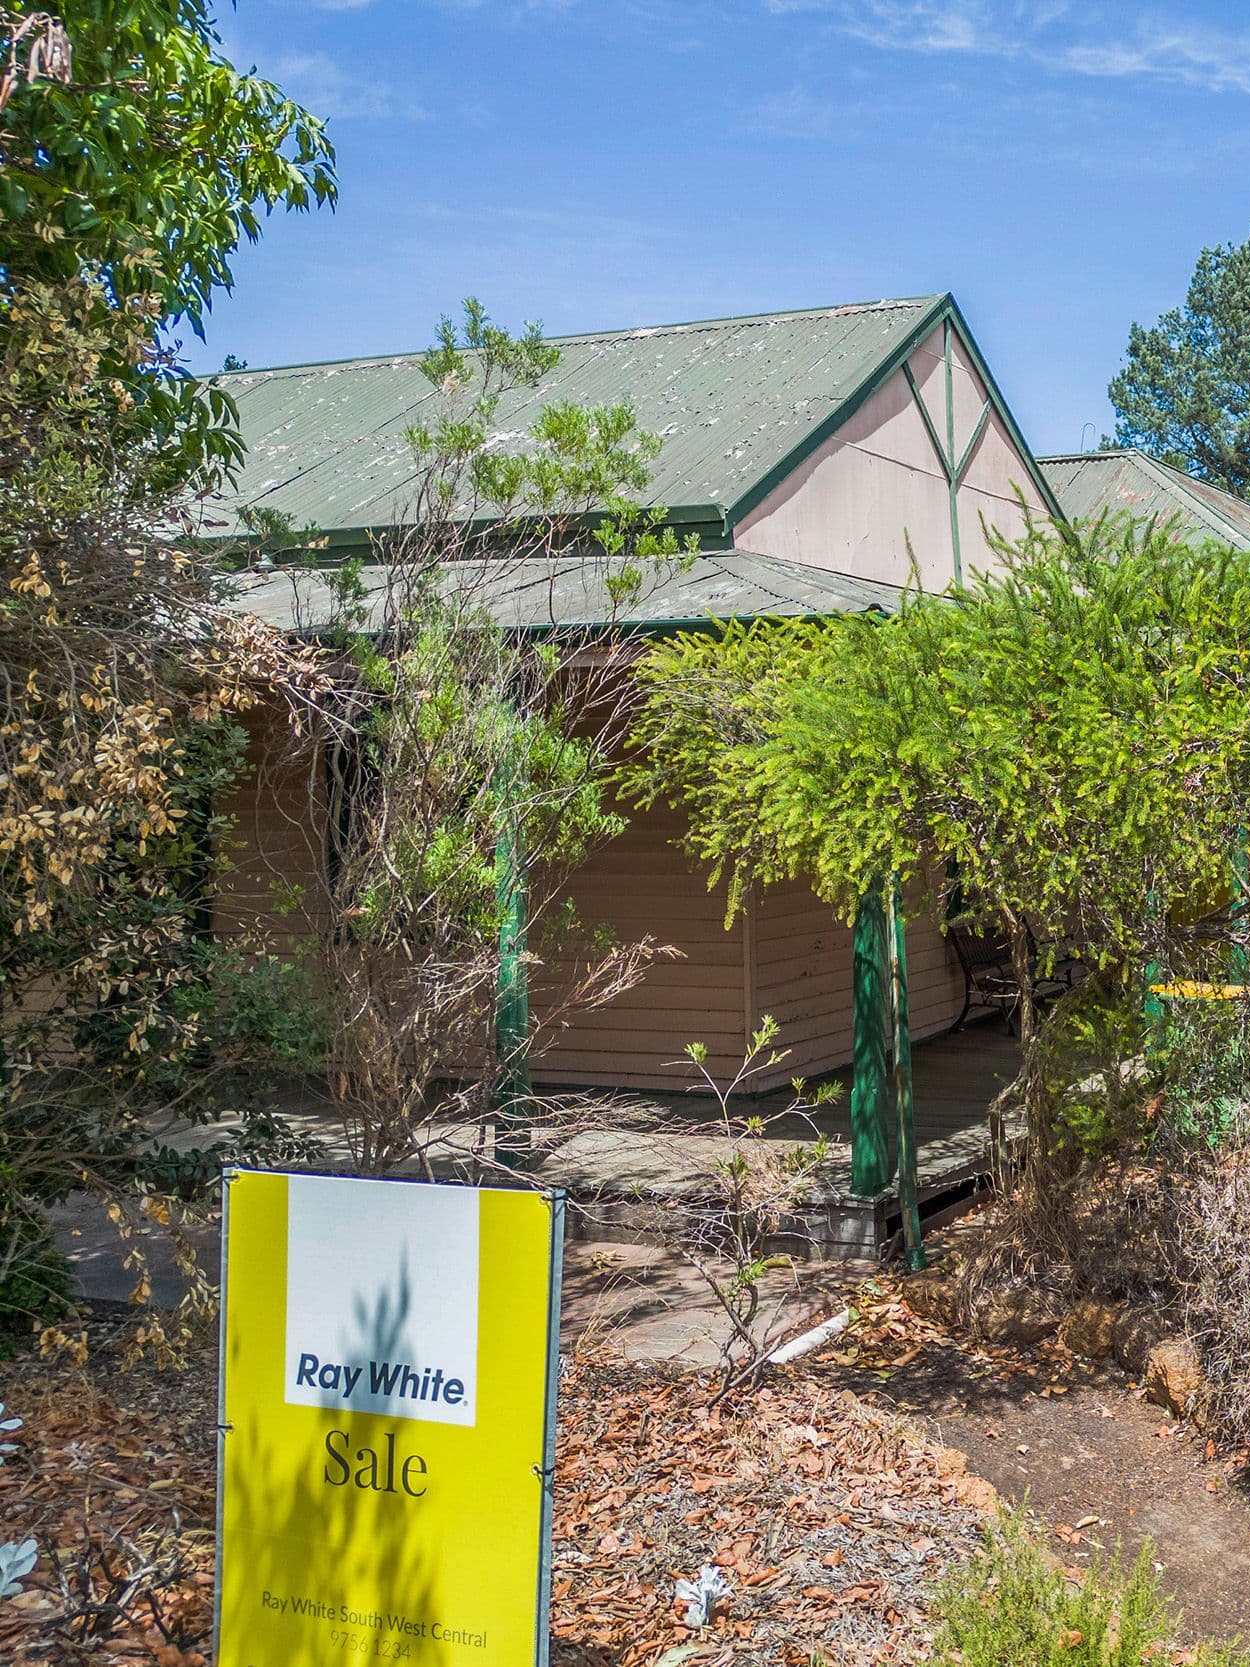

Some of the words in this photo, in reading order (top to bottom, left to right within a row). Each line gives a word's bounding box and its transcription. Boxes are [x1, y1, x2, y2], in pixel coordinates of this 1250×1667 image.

[296, 1353, 362, 1398] Ray
[369, 1361, 465, 1405] White
[324, 1430, 428, 1497] Sale
[262, 1591, 288, 1614] Ray
[290, 1596, 336, 1620] White
[339, 1606, 383, 1629] South
[387, 1614, 427, 1637] West
[431, 1622, 488, 1648] Central
[330, 1630, 369, 1653] 9756
[373, 1639, 411, 1660] 1234
